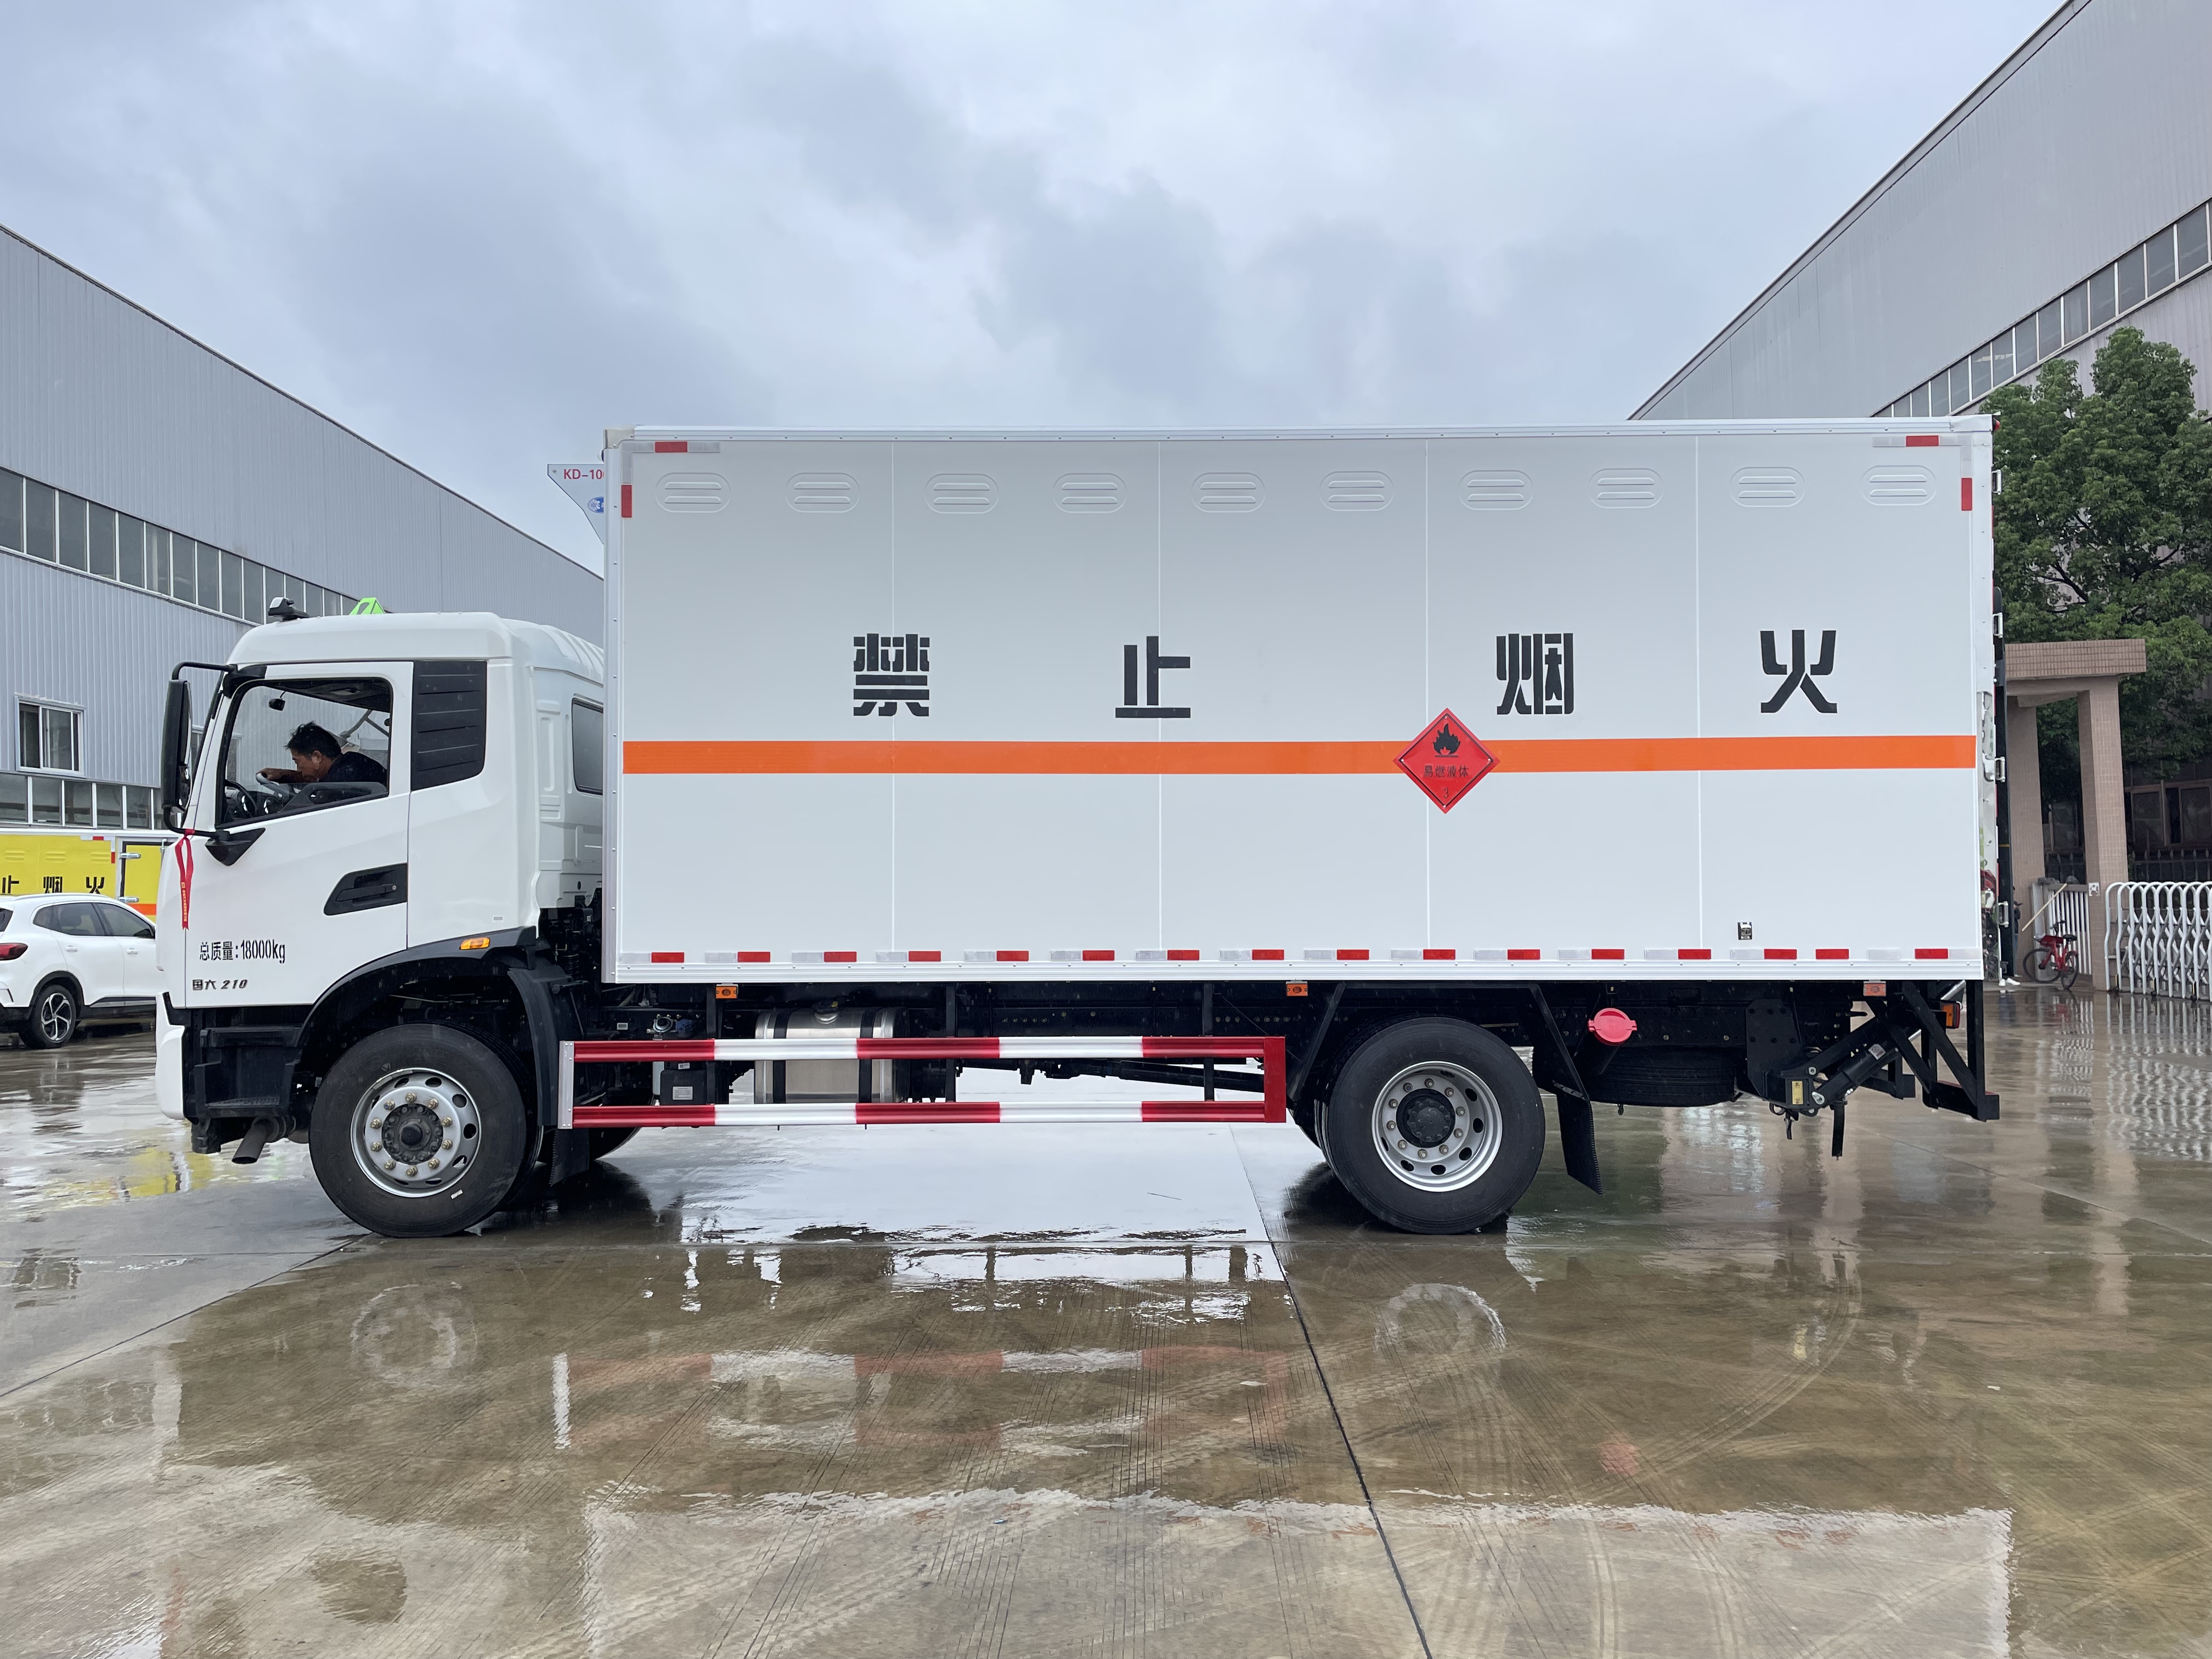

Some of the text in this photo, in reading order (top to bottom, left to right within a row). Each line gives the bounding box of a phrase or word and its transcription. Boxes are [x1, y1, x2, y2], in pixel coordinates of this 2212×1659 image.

[563, 468, 604, 480] KD-10
[853, 629, 1838, 719] 禁 止 烟 火
[1424, 764, 1469, 778] 易燃液体
[1443, 787, 1449, 799] 3
[221, 979, 248, 989] 210
